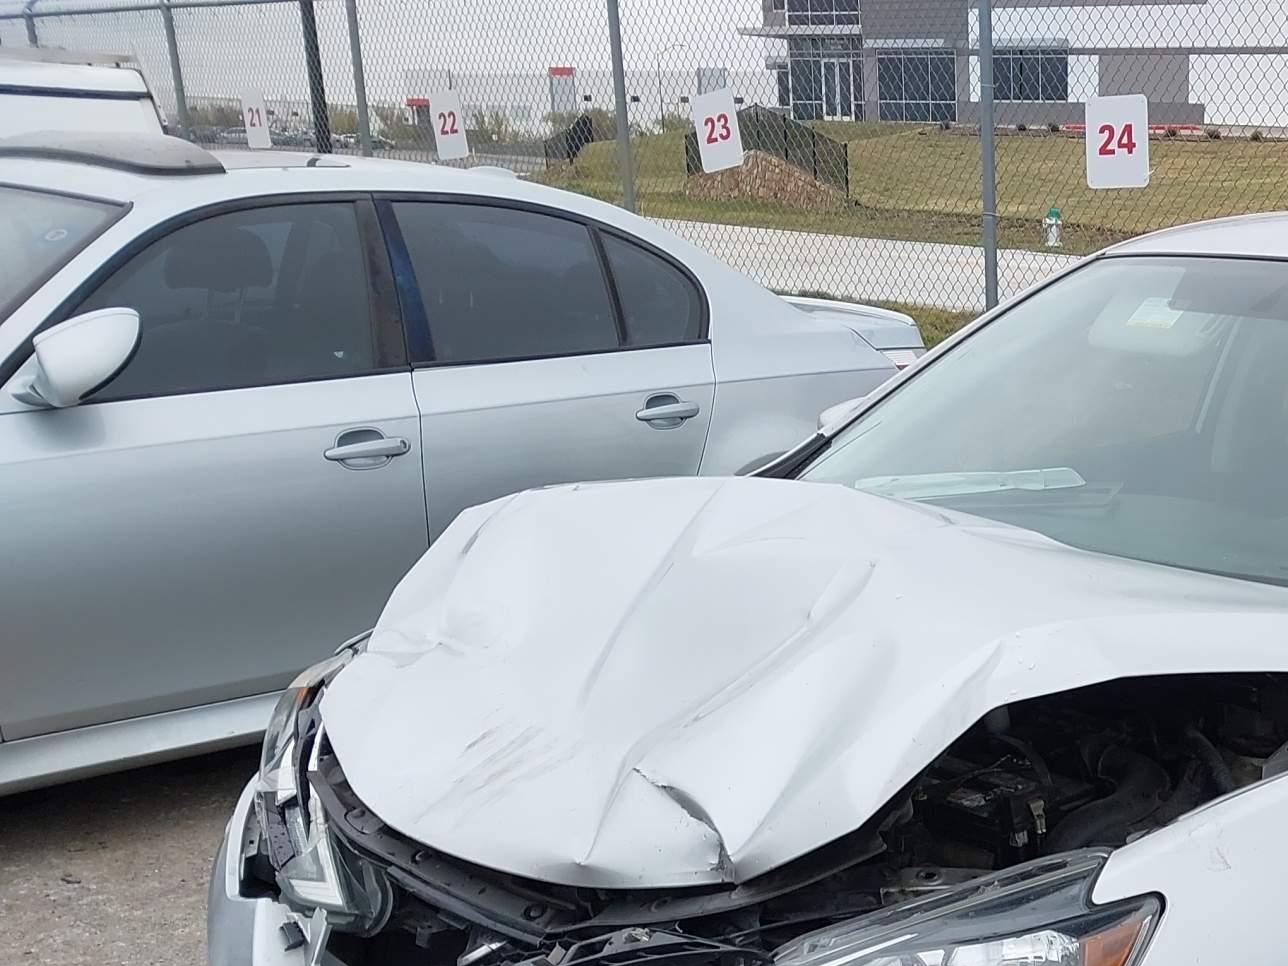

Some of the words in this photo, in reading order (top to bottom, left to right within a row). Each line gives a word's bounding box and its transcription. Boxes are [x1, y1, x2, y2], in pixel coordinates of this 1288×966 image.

[247, 107, 263, 128] 21
[438, 111, 459, 136] 22
[703, 112, 732, 145] 23
[1098, 123, 1136, 156] 24
